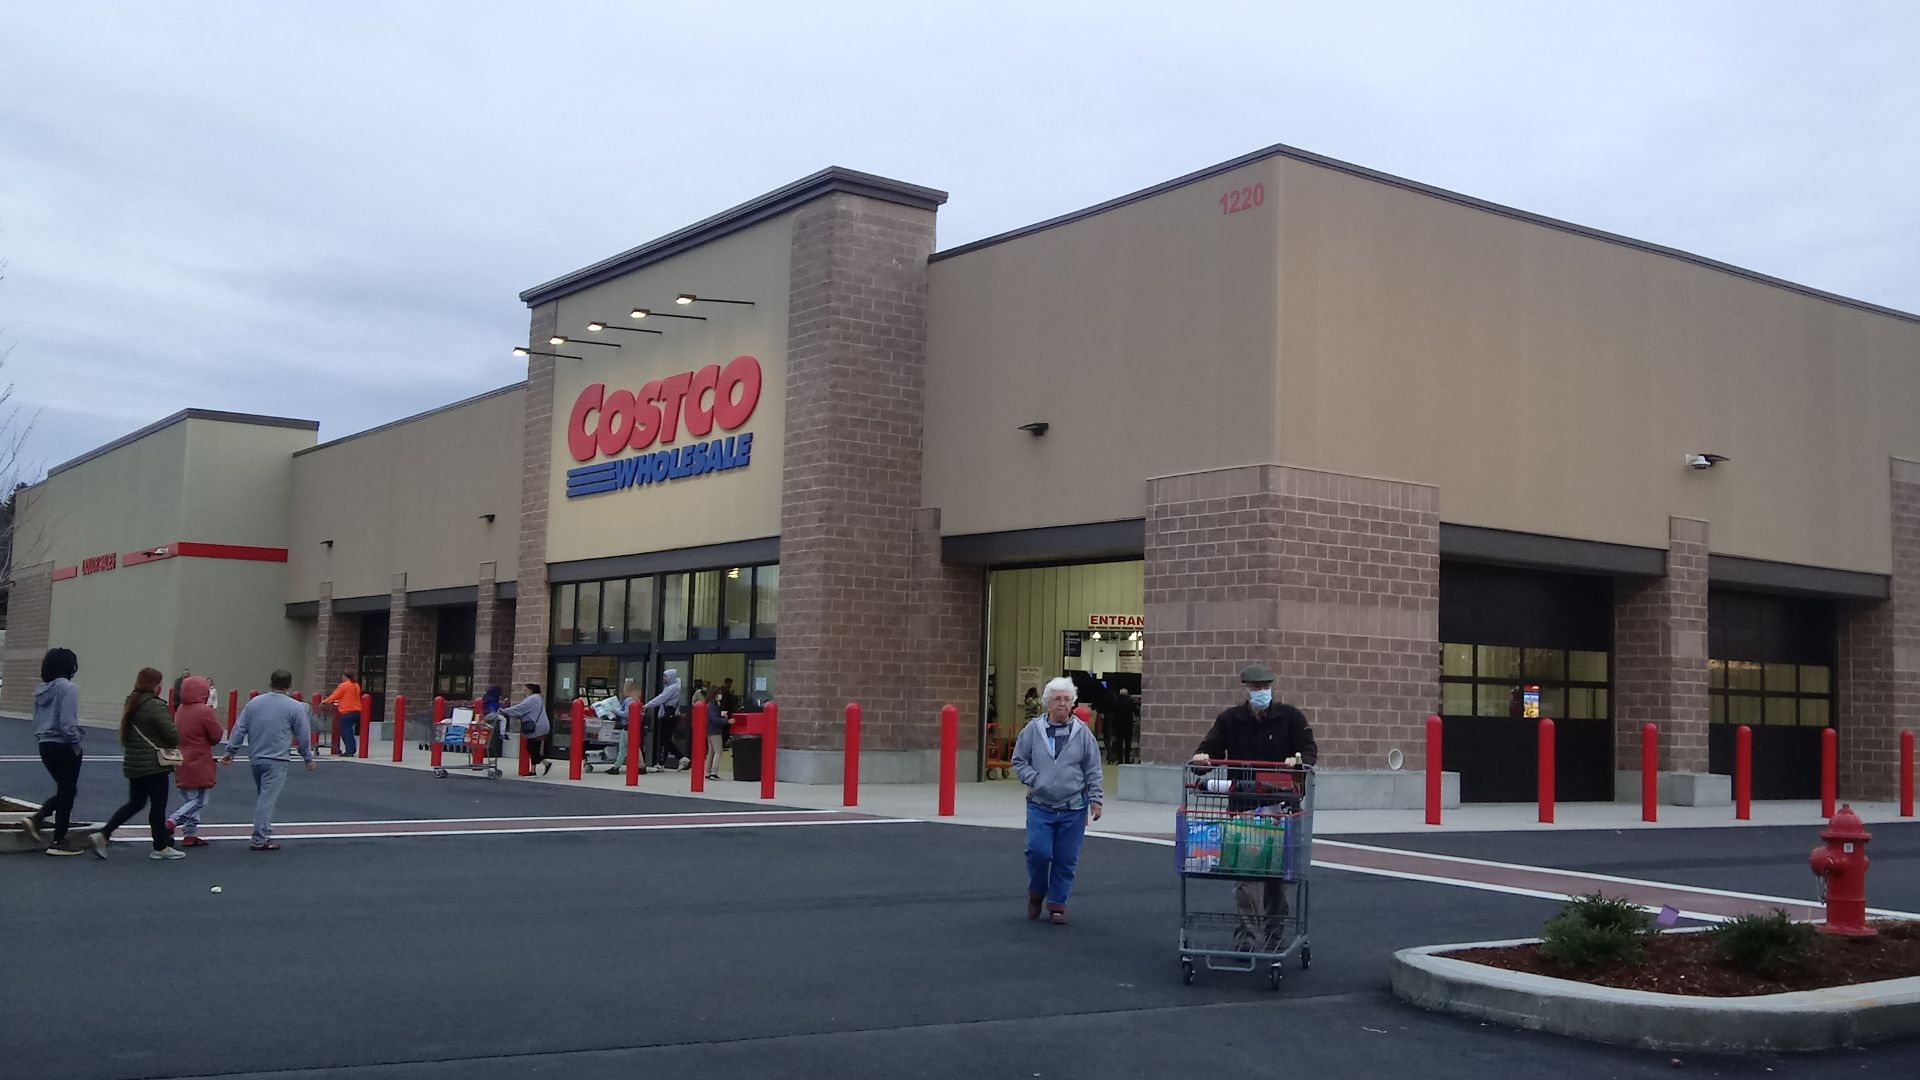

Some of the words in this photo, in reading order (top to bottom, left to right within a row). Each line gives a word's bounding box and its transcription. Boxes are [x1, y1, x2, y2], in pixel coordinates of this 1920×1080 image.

[1220, 182, 1265, 215] 1220
[567, 355, 763, 462] COSTCO
[614, 432, 754, 490] WHOLESALE
